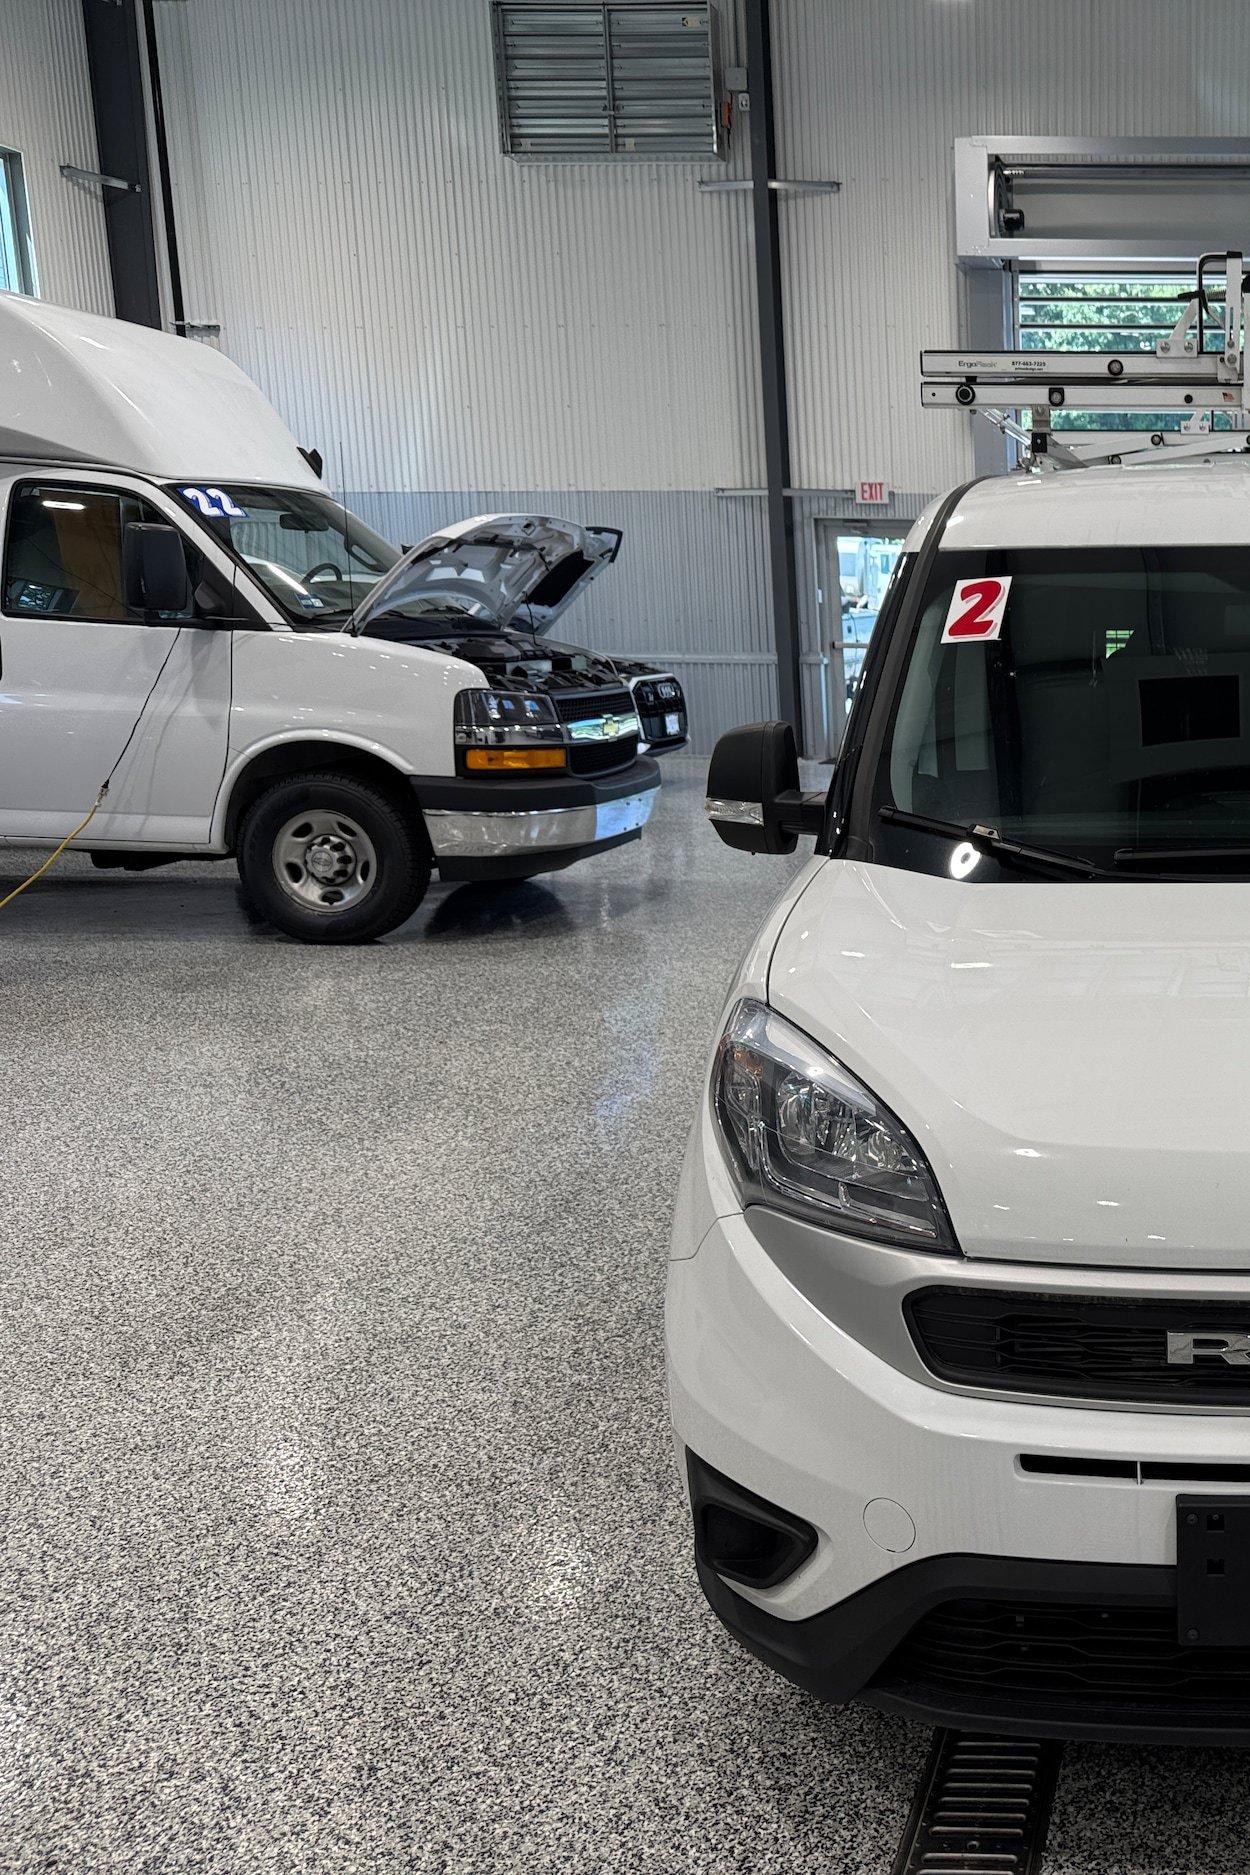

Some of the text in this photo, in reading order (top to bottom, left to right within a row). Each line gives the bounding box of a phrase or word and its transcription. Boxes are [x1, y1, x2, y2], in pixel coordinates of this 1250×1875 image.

[182, 487, 247, 517] 22
[860, 482, 884, 501] EXIT
[948, 580, 1003, 638] 2
